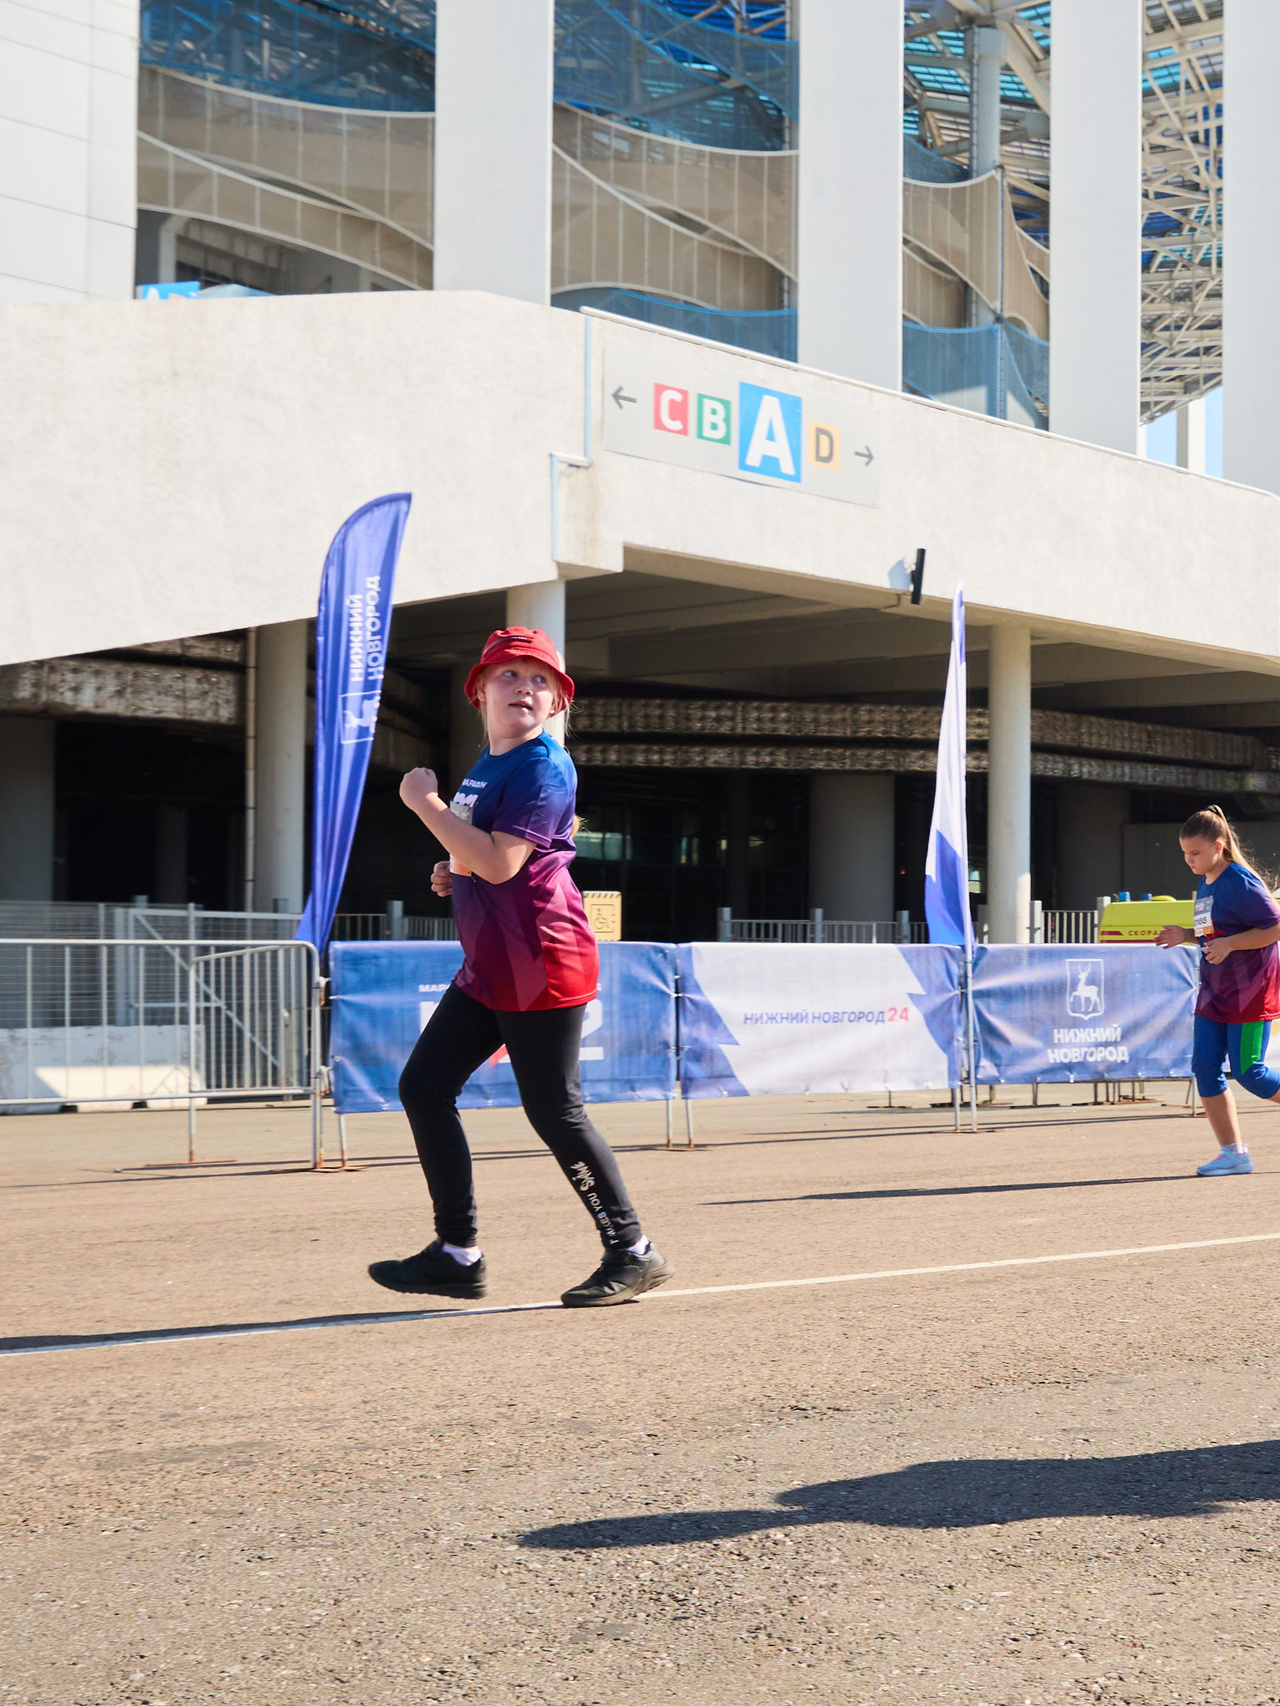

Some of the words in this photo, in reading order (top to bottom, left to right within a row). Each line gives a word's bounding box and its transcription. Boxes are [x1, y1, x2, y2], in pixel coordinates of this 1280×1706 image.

[660, 389, 684, 431] C
[701, 398, 727, 440] B
[744, 394, 796, 476] A
[815, 426, 834, 464] D
[347, 594, 364, 682] НИЖНИЙ
[366, 575, 385, 681] НОВГОРОД
[743, 1009, 809, 1025] НИЖНИЙ
[811, 1010, 886, 1025] НОВГОРОД
[887, 1006, 909, 1023] 24
[1053, 1023, 1122, 1044] НИЖНИЙ
[1047, 1046, 1130, 1064] НОВГОРОД
[587, 1192, 603, 1212] YOU
